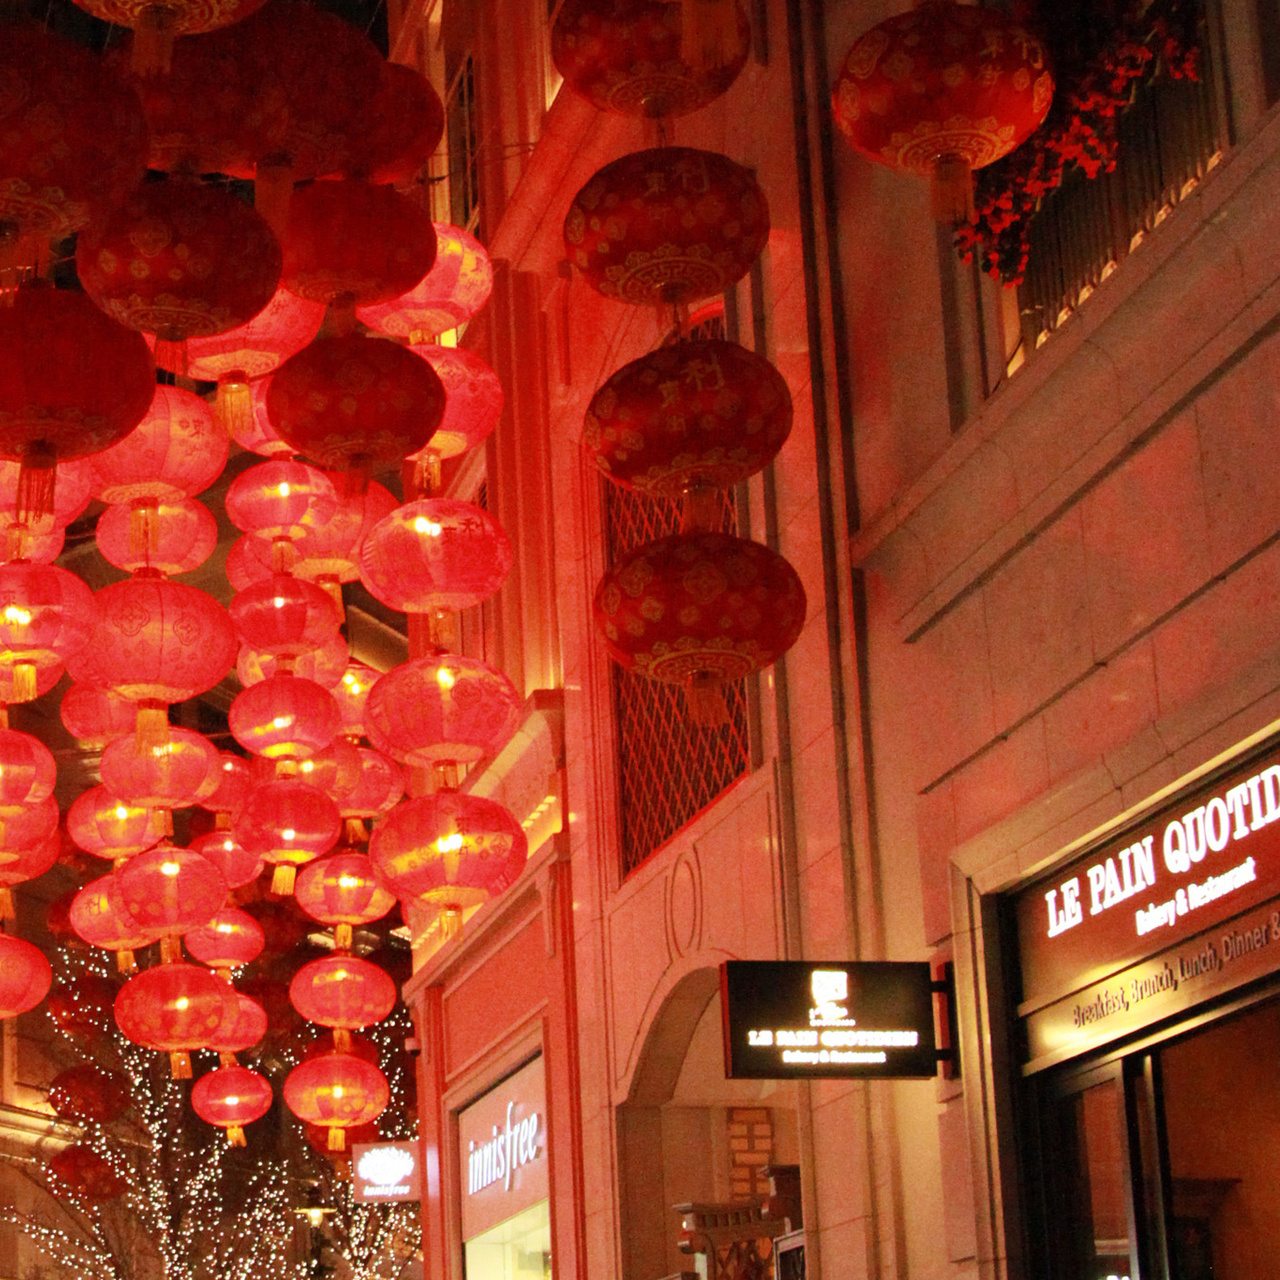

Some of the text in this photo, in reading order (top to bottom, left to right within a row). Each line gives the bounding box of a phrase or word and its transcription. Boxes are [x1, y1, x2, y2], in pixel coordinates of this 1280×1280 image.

[1045, 878, 1083, 938] LE
[1087, 835, 1156, 915] PAIN
[1135, 856, 1257, 936] Bakery & Restaurant
[1072, 986, 1130, 1028] Breakfast,
[1129, 962, 1178, 1002] Brunch,
[1178, 942, 1222, 981] Lunch,
[1221, 924, 1270, 962] Dinner
[363, 1185, 410, 1197] innisfree
[468, 1101, 538, 1195] innisfree
